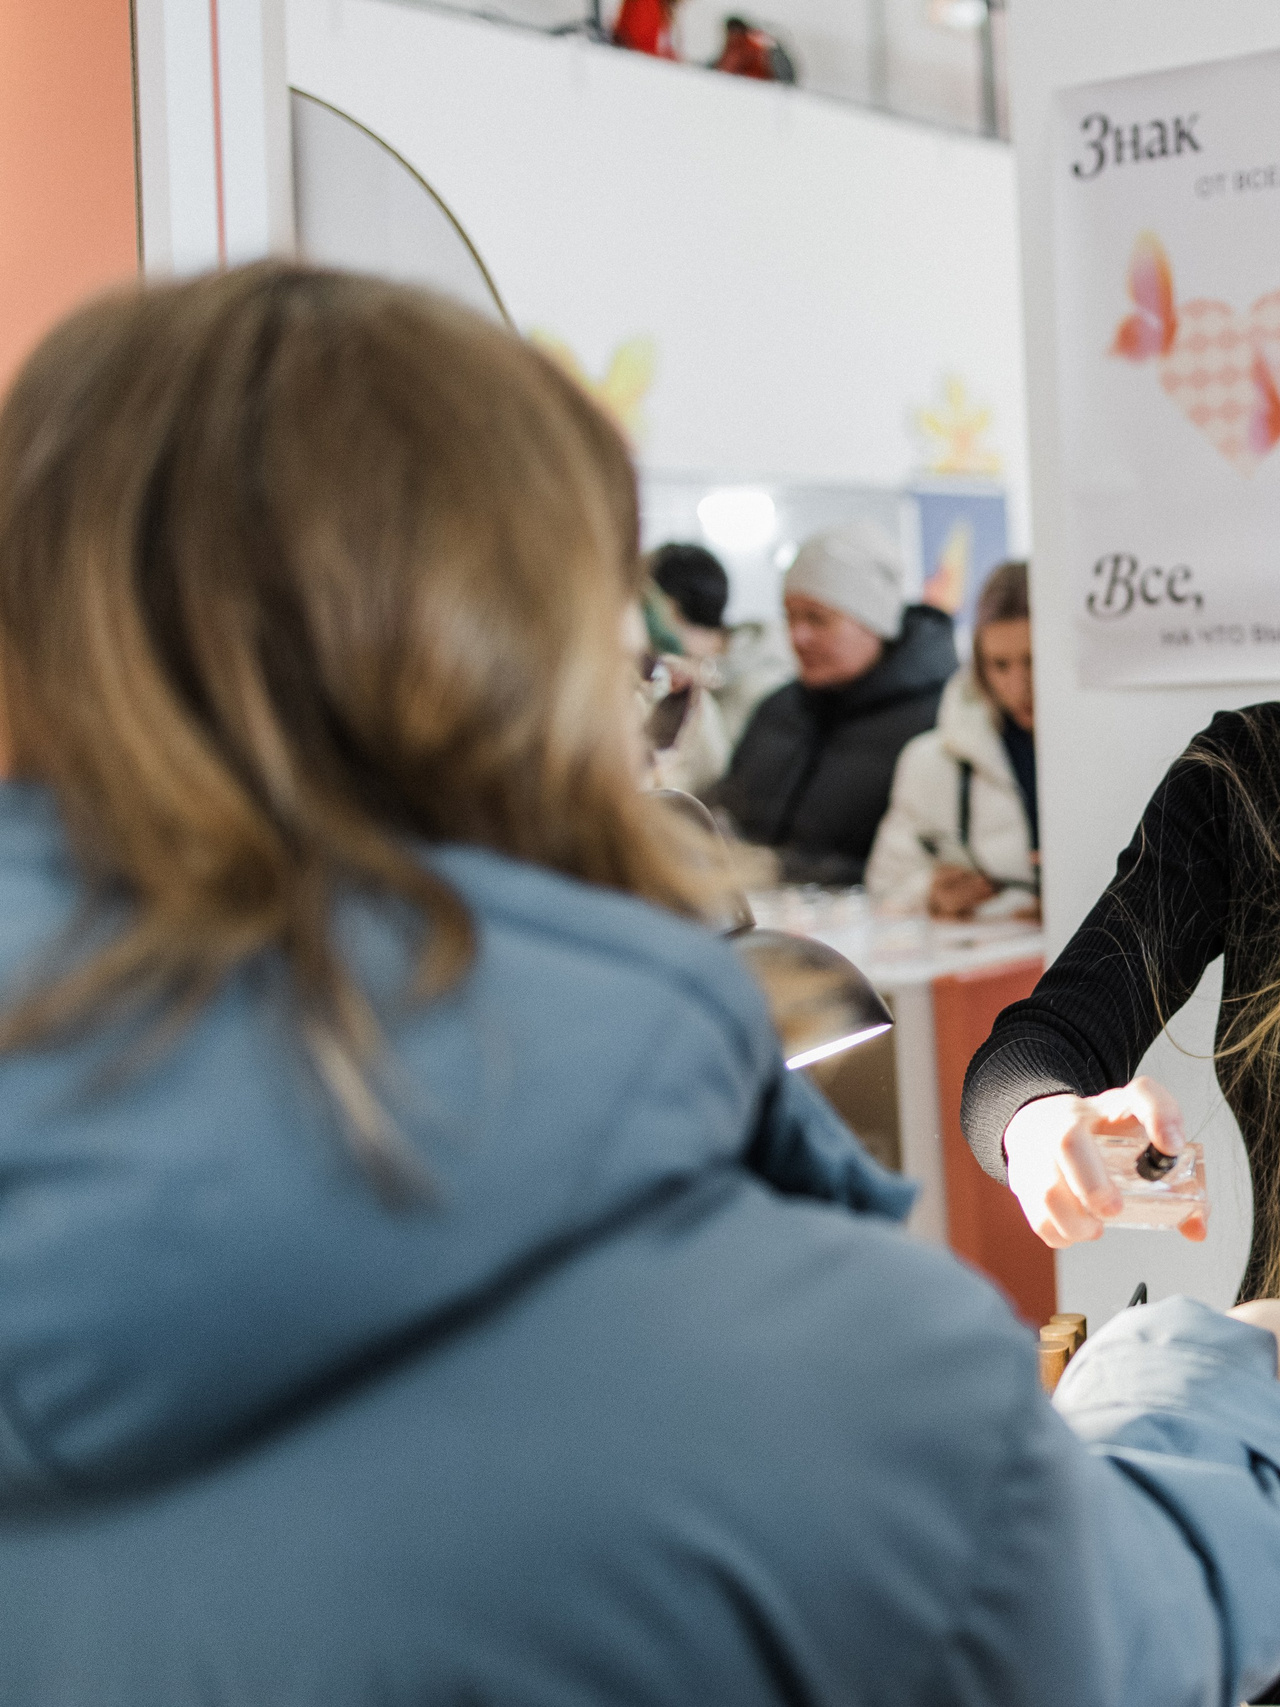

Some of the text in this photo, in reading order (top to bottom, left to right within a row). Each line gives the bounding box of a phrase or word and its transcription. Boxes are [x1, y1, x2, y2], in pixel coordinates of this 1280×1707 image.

[1070, 111, 1203, 182] Знак
[1194, 172, 1226, 198] ОТ
[1085, 552, 1204, 621] Все,
